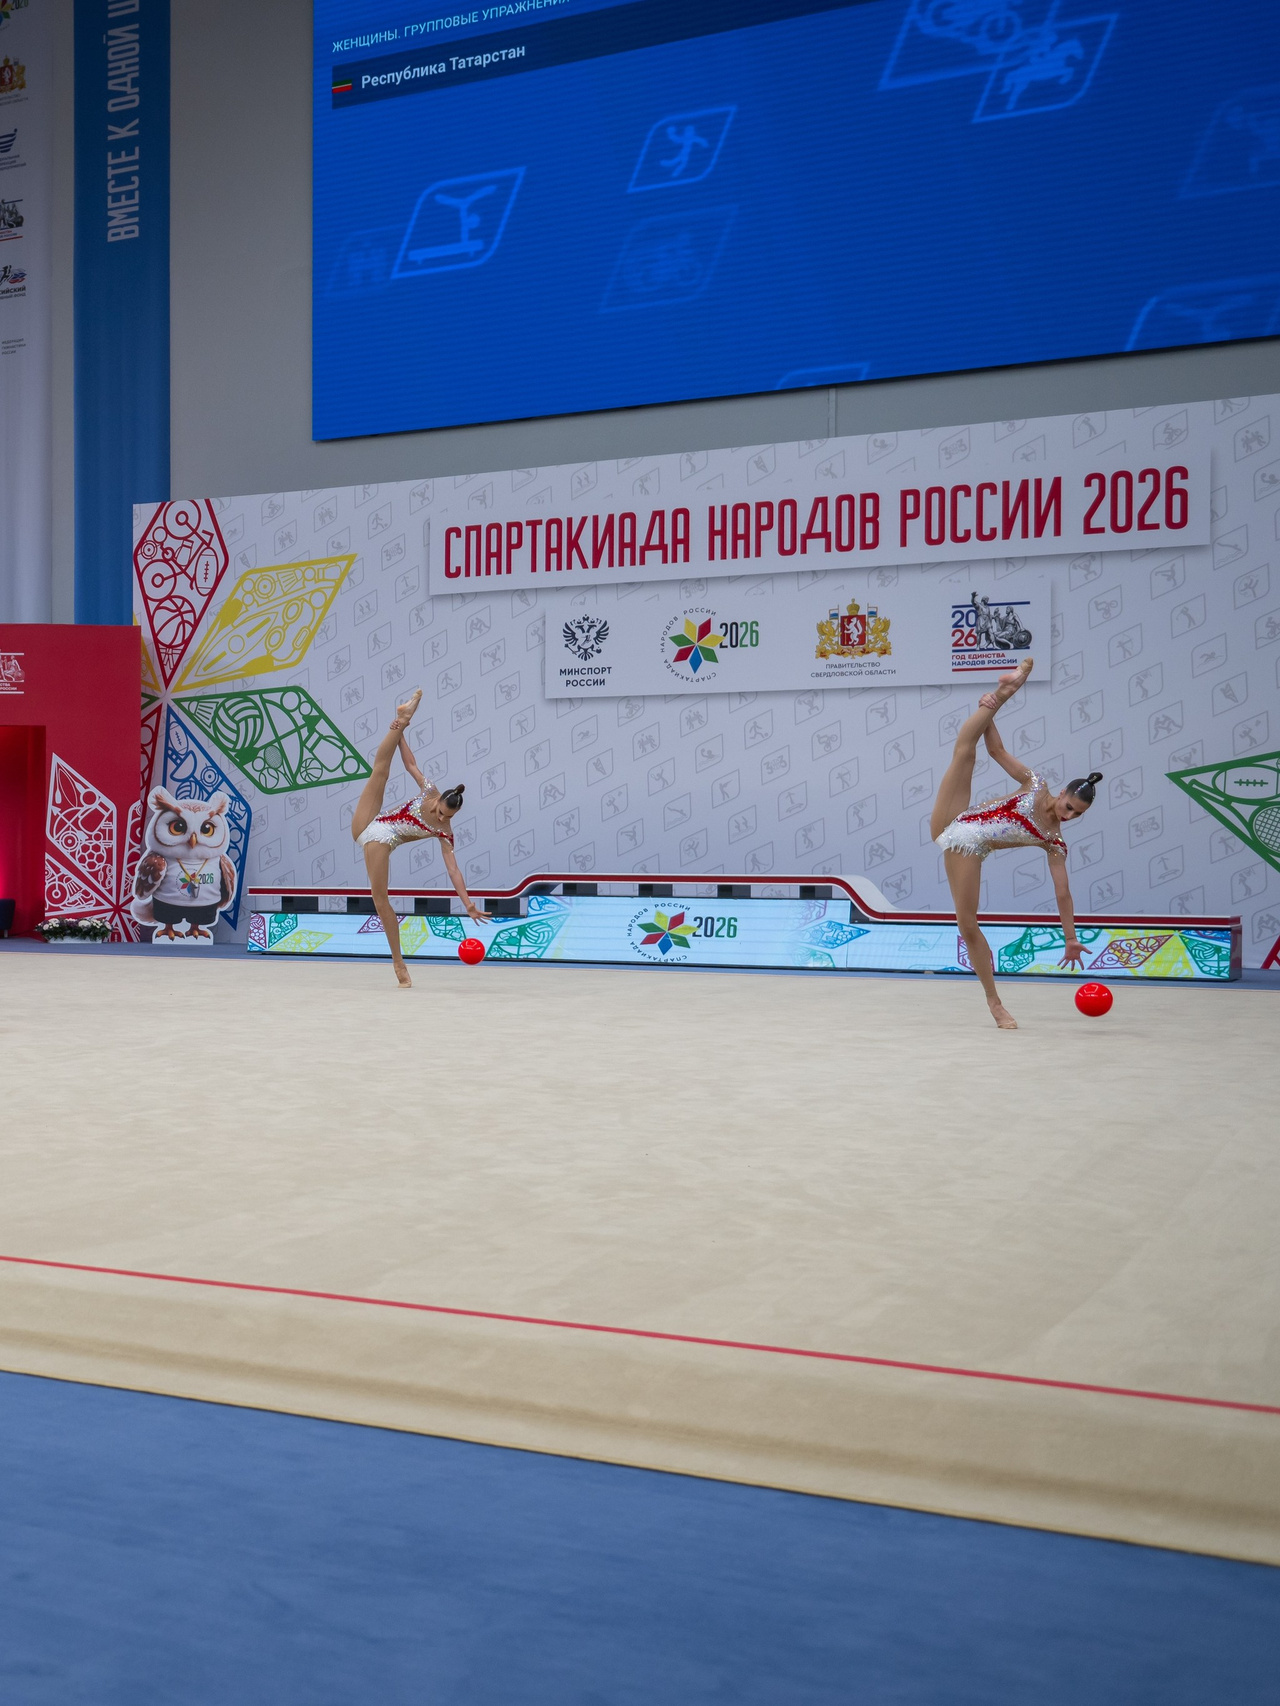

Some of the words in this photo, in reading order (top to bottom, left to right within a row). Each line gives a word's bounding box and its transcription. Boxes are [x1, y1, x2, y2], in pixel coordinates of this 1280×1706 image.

[332, 29, 401, 53] ЖЕНЩИНЫ.
[404, 11, 480, 37] ГРУППОВЫЕ
[482, 0, 570, 21] УПРАЖНЕНИ
[103, 23, 139, 113] ОДНОЙ
[361, 63, 446, 89] Республика
[449, 46, 526, 71] Татарстан
[107, 118, 139, 140] К
[107, 146, 139, 242] ВМЕСТЕ
[444, 507, 690, 578] СПАРТАКИАДА
[708, 492, 880, 561] НАРОДОВ
[899, 476, 1062, 548] РОССИИ
[1083, 465, 1189, 535] 2026
[683, 607, 717, 617] РОССИИ
[951, 609, 977, 628] 20
[661, 616, 679, 652] НАРОДОВ
[719, 620, 759, 649] 2026
[951, 628, 977, 647] 26
[825, 661, 880, 669] ПРАВИТЕЛЬСТВО
[951, 653, 966, 661] ГОД
[967, 652, 1006, 660] ЕДИНСТВА
[951, 659, 986, 667] НАРОДОВ
[988, 658, 1018, 666] РОССИИ
[559, 666, 612, 676] МИНСПОРТ
[663, 659, 717, 683] СПАРТАКИАДА
[810, 669, 863, 678] СВЕРДЛОВСКОЙ
[865, 669, 896, 677] ОБЛАСТИ
[565, 678, 606, 687] РОССИИ
[654, 902, 691, 911] РОССИИ
[627, 908, 649, 937] НАРОДОВ
[692, 916, 738, 938] 2026
[630, 941, 687, 962] СПАРТАКИАДА
